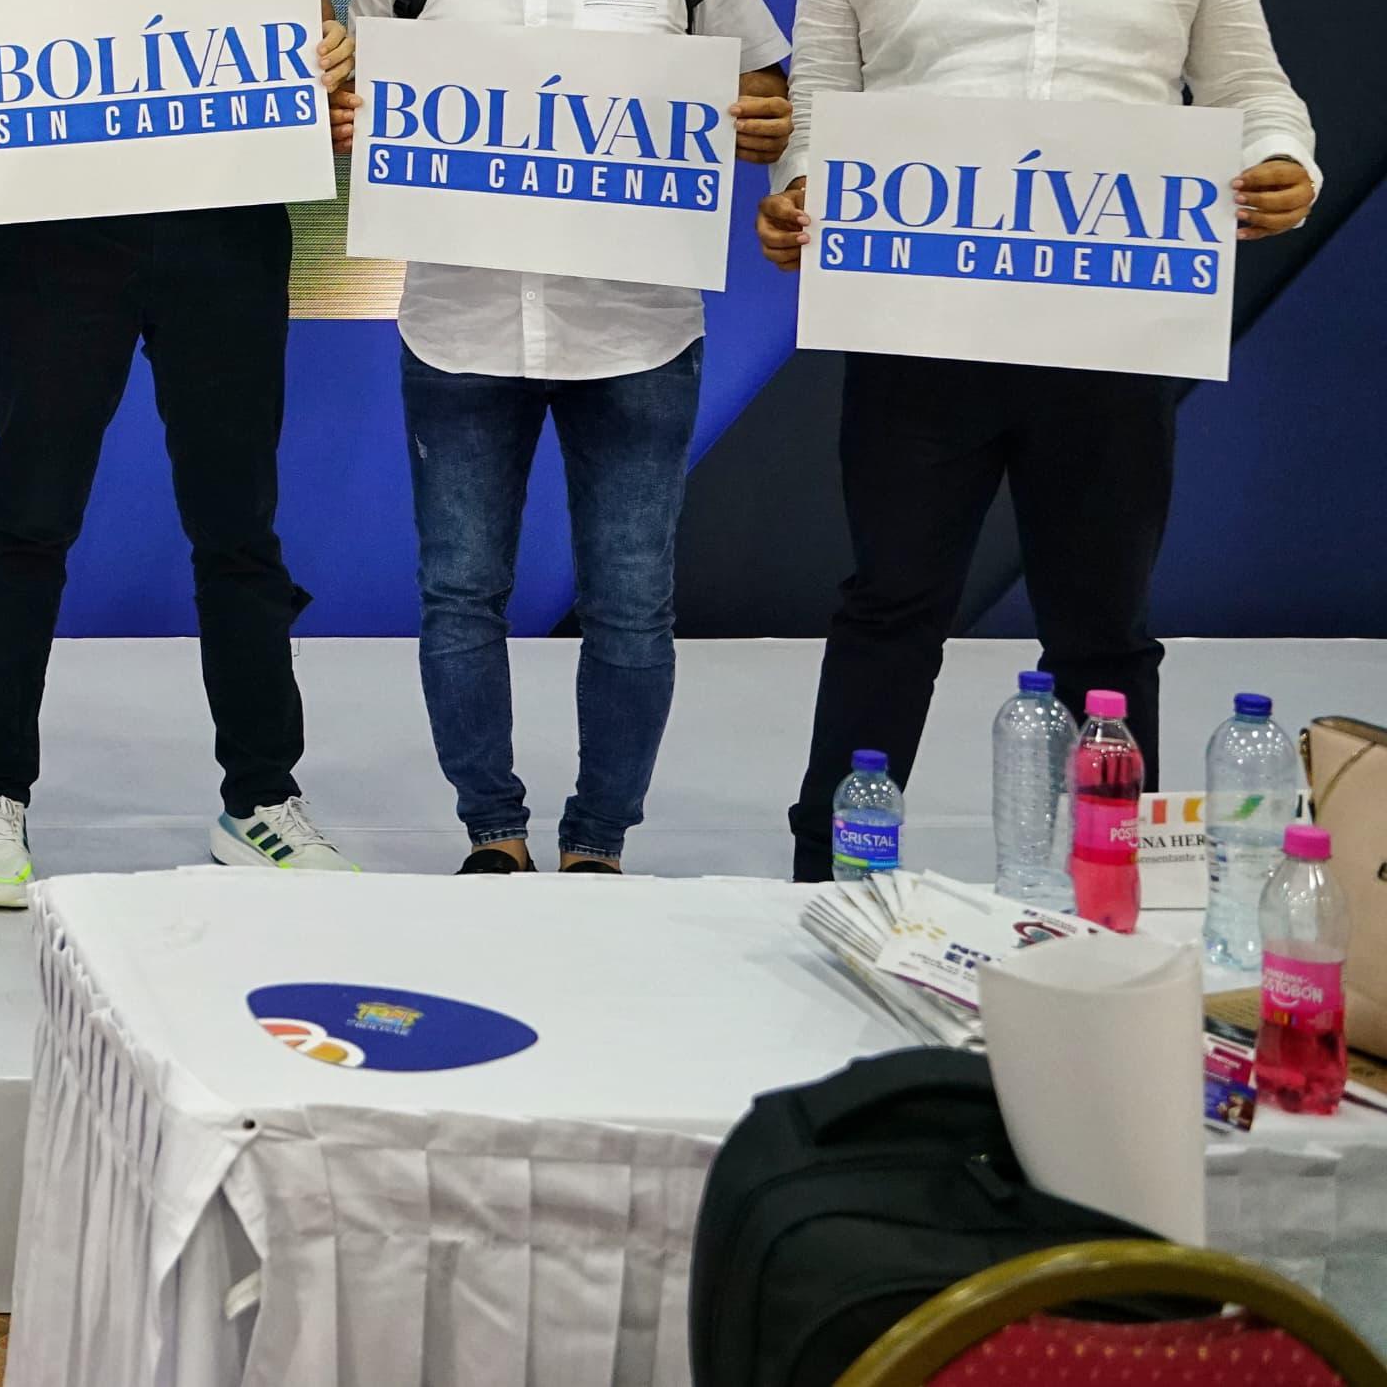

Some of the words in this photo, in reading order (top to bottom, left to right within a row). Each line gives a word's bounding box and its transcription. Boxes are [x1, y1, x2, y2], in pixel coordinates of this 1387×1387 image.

[105, 90, 312, 135] CADENAS
[368, 74, 721, 165] BOLÍVAR
[374, 149, 448, 184] SIN
[489, 158, 714, 206] CADENAS
[820, 148, 1223, 244] BOLÍVAR
[826, 233, 912, 269] SIN
[957, 241, 1213, 288] CADENAS
[840, 829, 897, 847] CRISTAL
